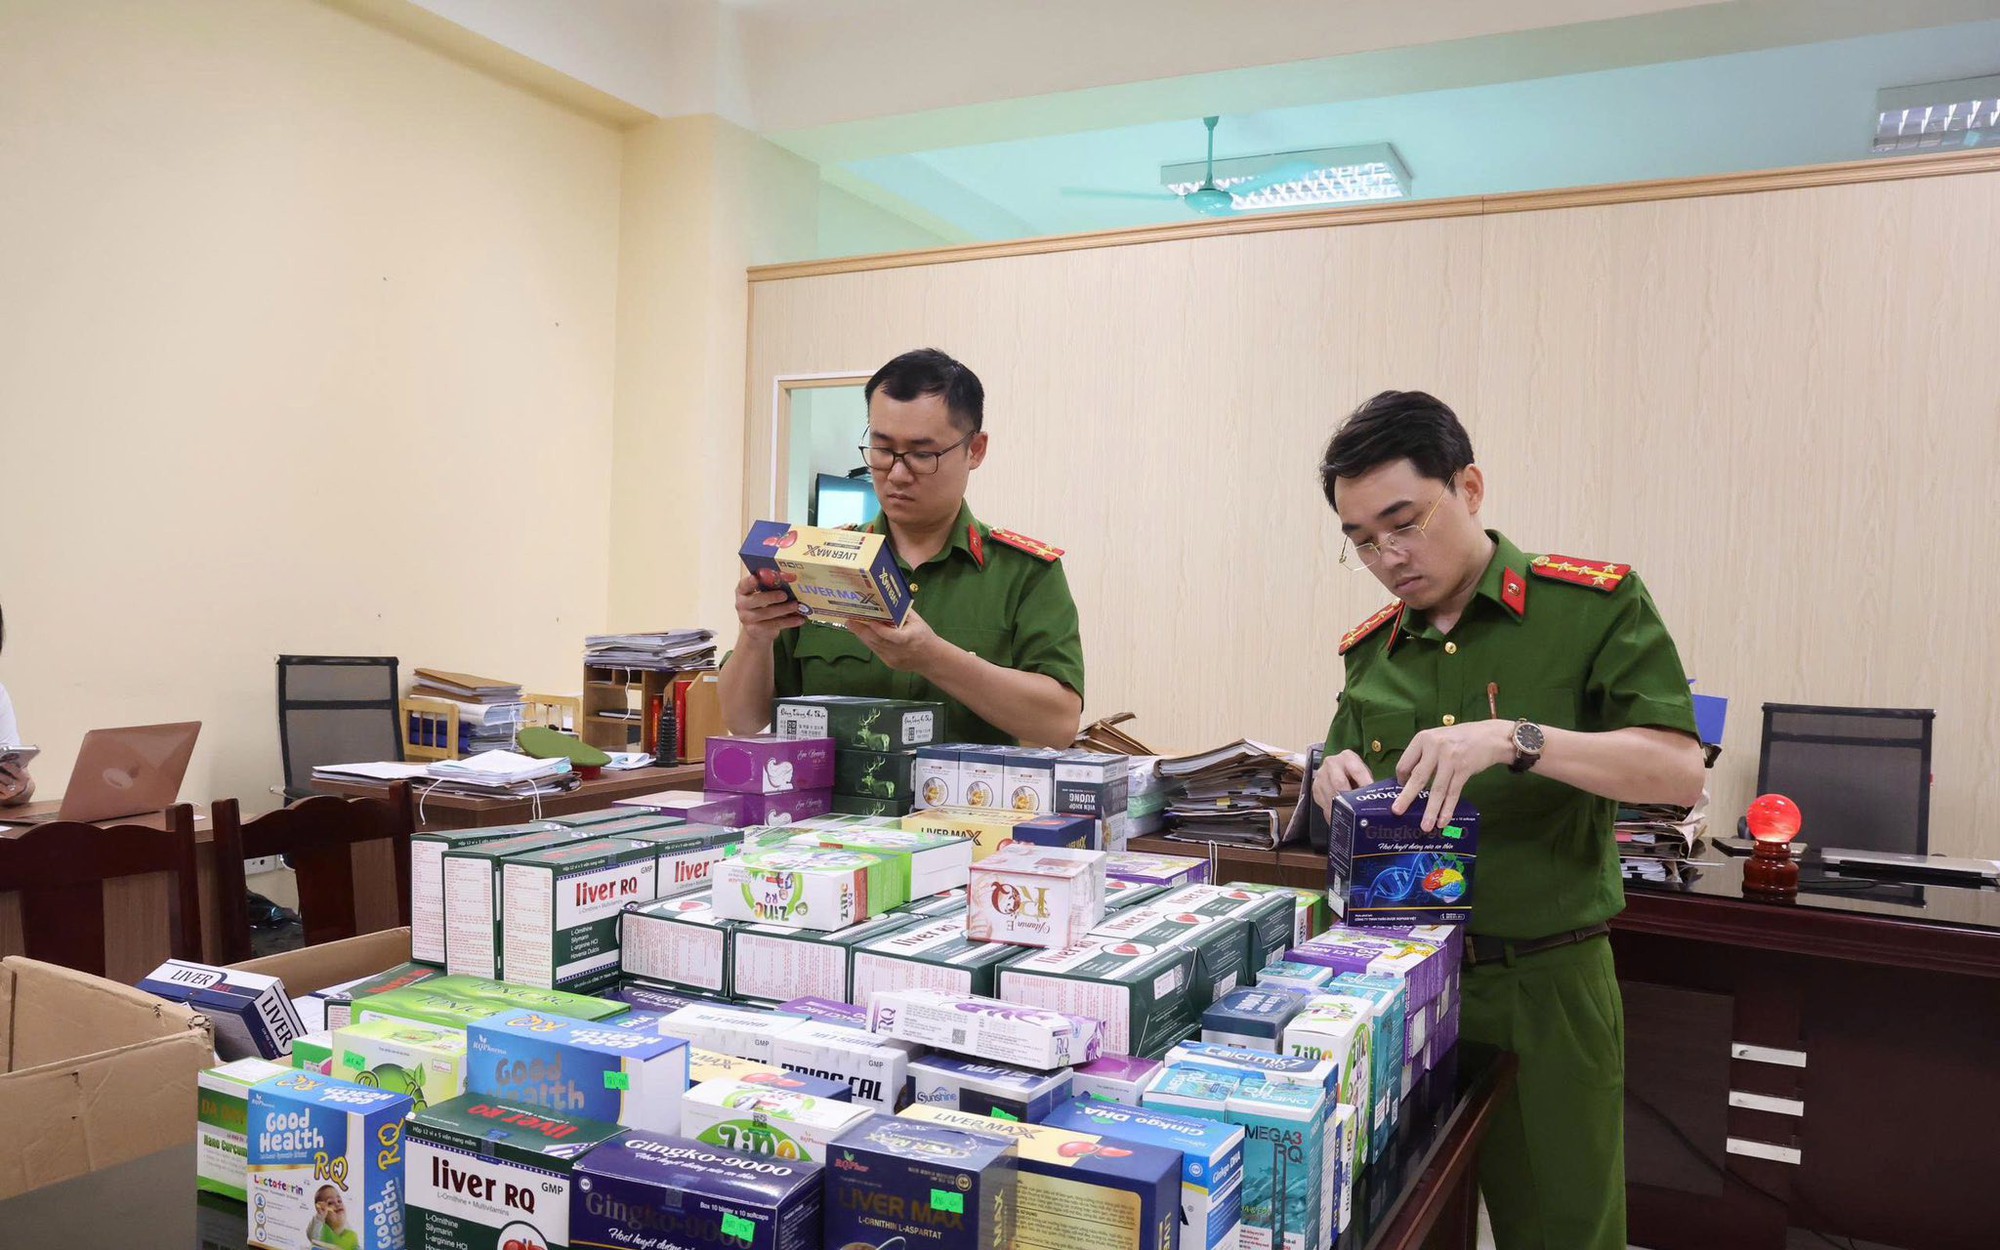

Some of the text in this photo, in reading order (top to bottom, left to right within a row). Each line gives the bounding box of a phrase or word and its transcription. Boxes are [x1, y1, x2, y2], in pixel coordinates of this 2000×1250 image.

[802, 544, 857, 561] LIVER MAX
[798, 584, 880, 606] LIVER MAX
[674, 859, 710, 883] liver
[576, 881, 616, 907] liver
[620, 877, 638, 895] RQ
[991, 881, 1050, 920] RQ
[891, 927, 940, 947] liver
[1035, 944, 1074, 964] liver
[171, 969, 213, 986] LIVER
[262, 996, 293, 1047] LIVER
[755, 1039, 769, 1048] GMP
[496, 1051, 562, 1086] Good
[868, 1060, 884, 1069] GMP
[488, 1079, 585, 1109] ealth
[917, 1089, 957, 1104] Sunshine
[266, 1108, 310, 1132] Good
[934, 1113, 1046, 1140] LIVER MAX
[1083, 1106, 1204, 1137] DHA Ginkgo
[260, 1127, 324, 1153] Health
[378, 1117, 405, 1171] RQ
[1233, 1121, 1303, 1146] MEGA3
[625, 1139, 792, 1177] Gingko-9000
[314, 1152, 349, 1192] RQ
[254, 1174, 303, 1196] Lactoferrin
[432, 1156, 535, 1215] liver RQ
[541, 1182, 564, 1196] GMP
[838, 1186, 905, 1220] LIVER
[368, 1202, 391, 1249] Good
[425, 1213, 459, 1228] L-Ornithine
[425, 1223, 453, 1237] Silymarin
[858, 1216, 942, 1240] L-ORNITHIN L-ASPARTAT
